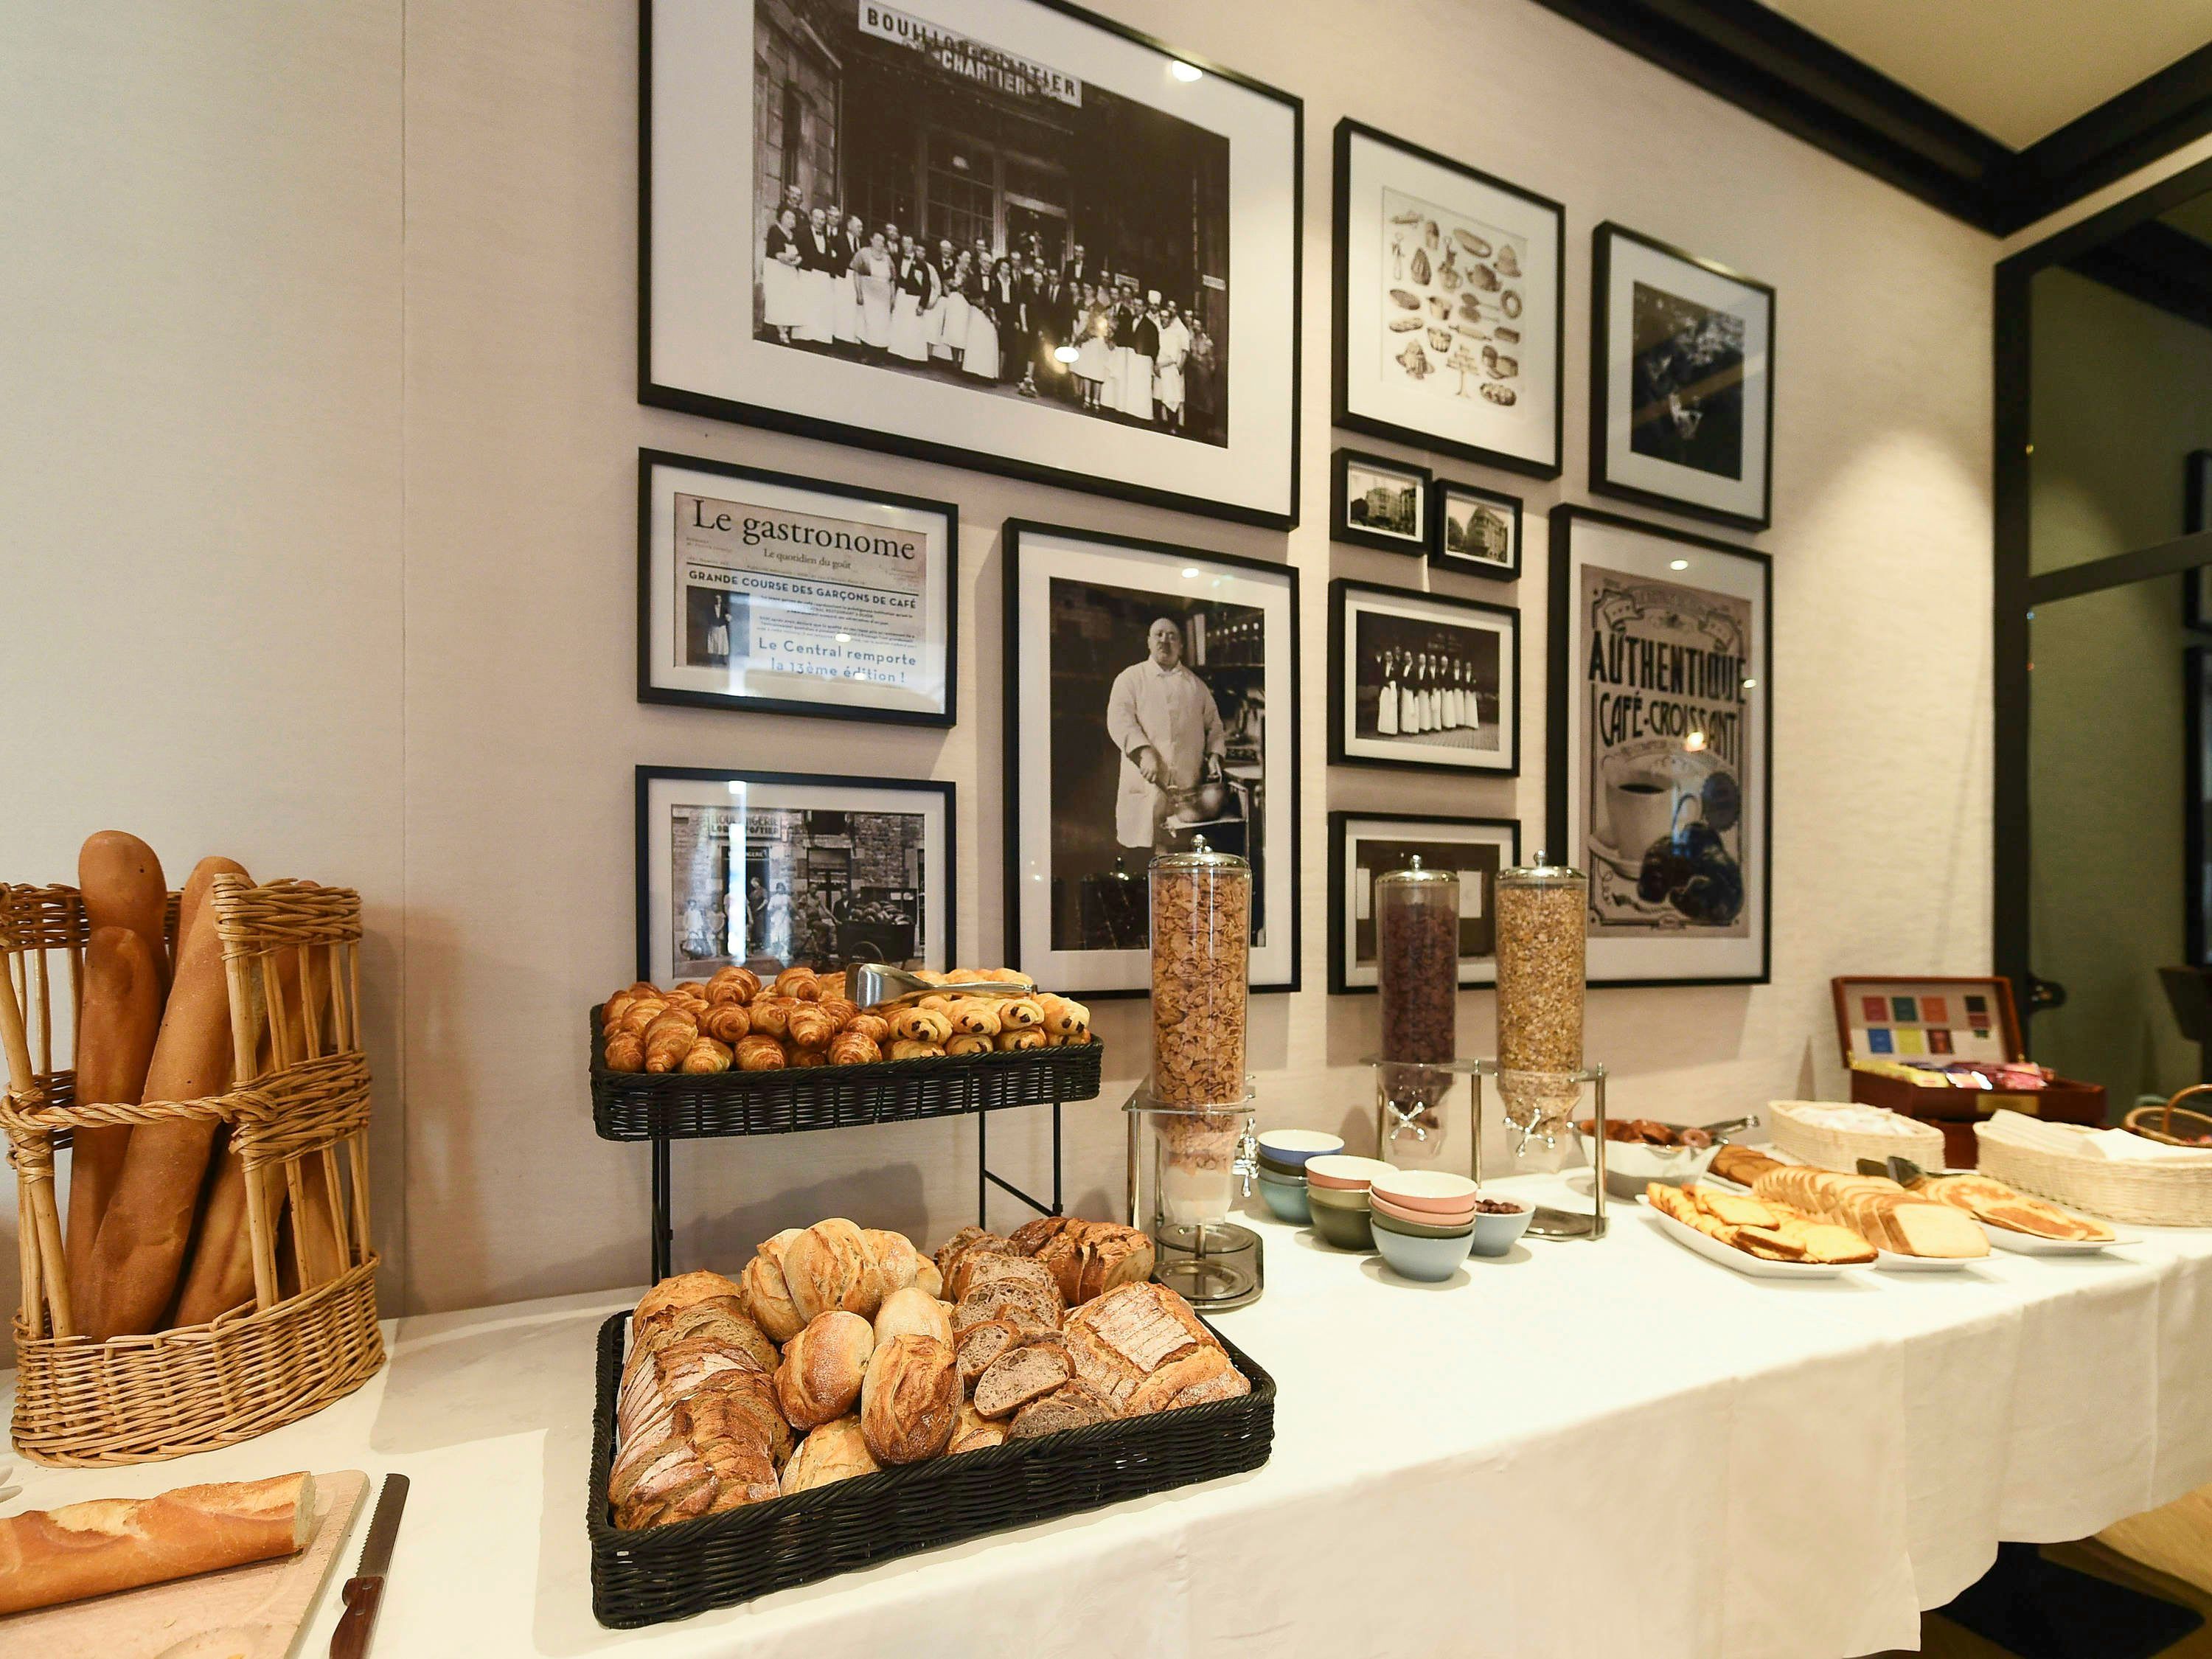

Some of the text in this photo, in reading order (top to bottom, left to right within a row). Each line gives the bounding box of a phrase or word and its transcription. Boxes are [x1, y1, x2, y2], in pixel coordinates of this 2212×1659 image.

[867, 7, 967, 54] BOUILLO
[942, 49, 1026, 96] CHARTIER
[692, 499, 916, 560] Le gastronome
[763, 549, 774, 559] Le
[776, 552, 817, 565] quotidien
[819, 554, 832, 567] du
[689, 570, 738, 585] GRANDE
[742, 577, 788, 592] COURSE
[792, 585, 813, 596] DES
[816, 588, 870, 603] GARÇONS
[873, 594, 886, 605] DE
[889, 597, 917, 609] CAFÉ
[759, 637, 777, 650] Le
[784, 639, 841, 658] Central
[847, 650, 917, 666] remporte
[771, 657, 784, 671] la
[790, 661, 838, 675] 13ème
[1589, 630, 1747, 704] AUTHENTIQUE
